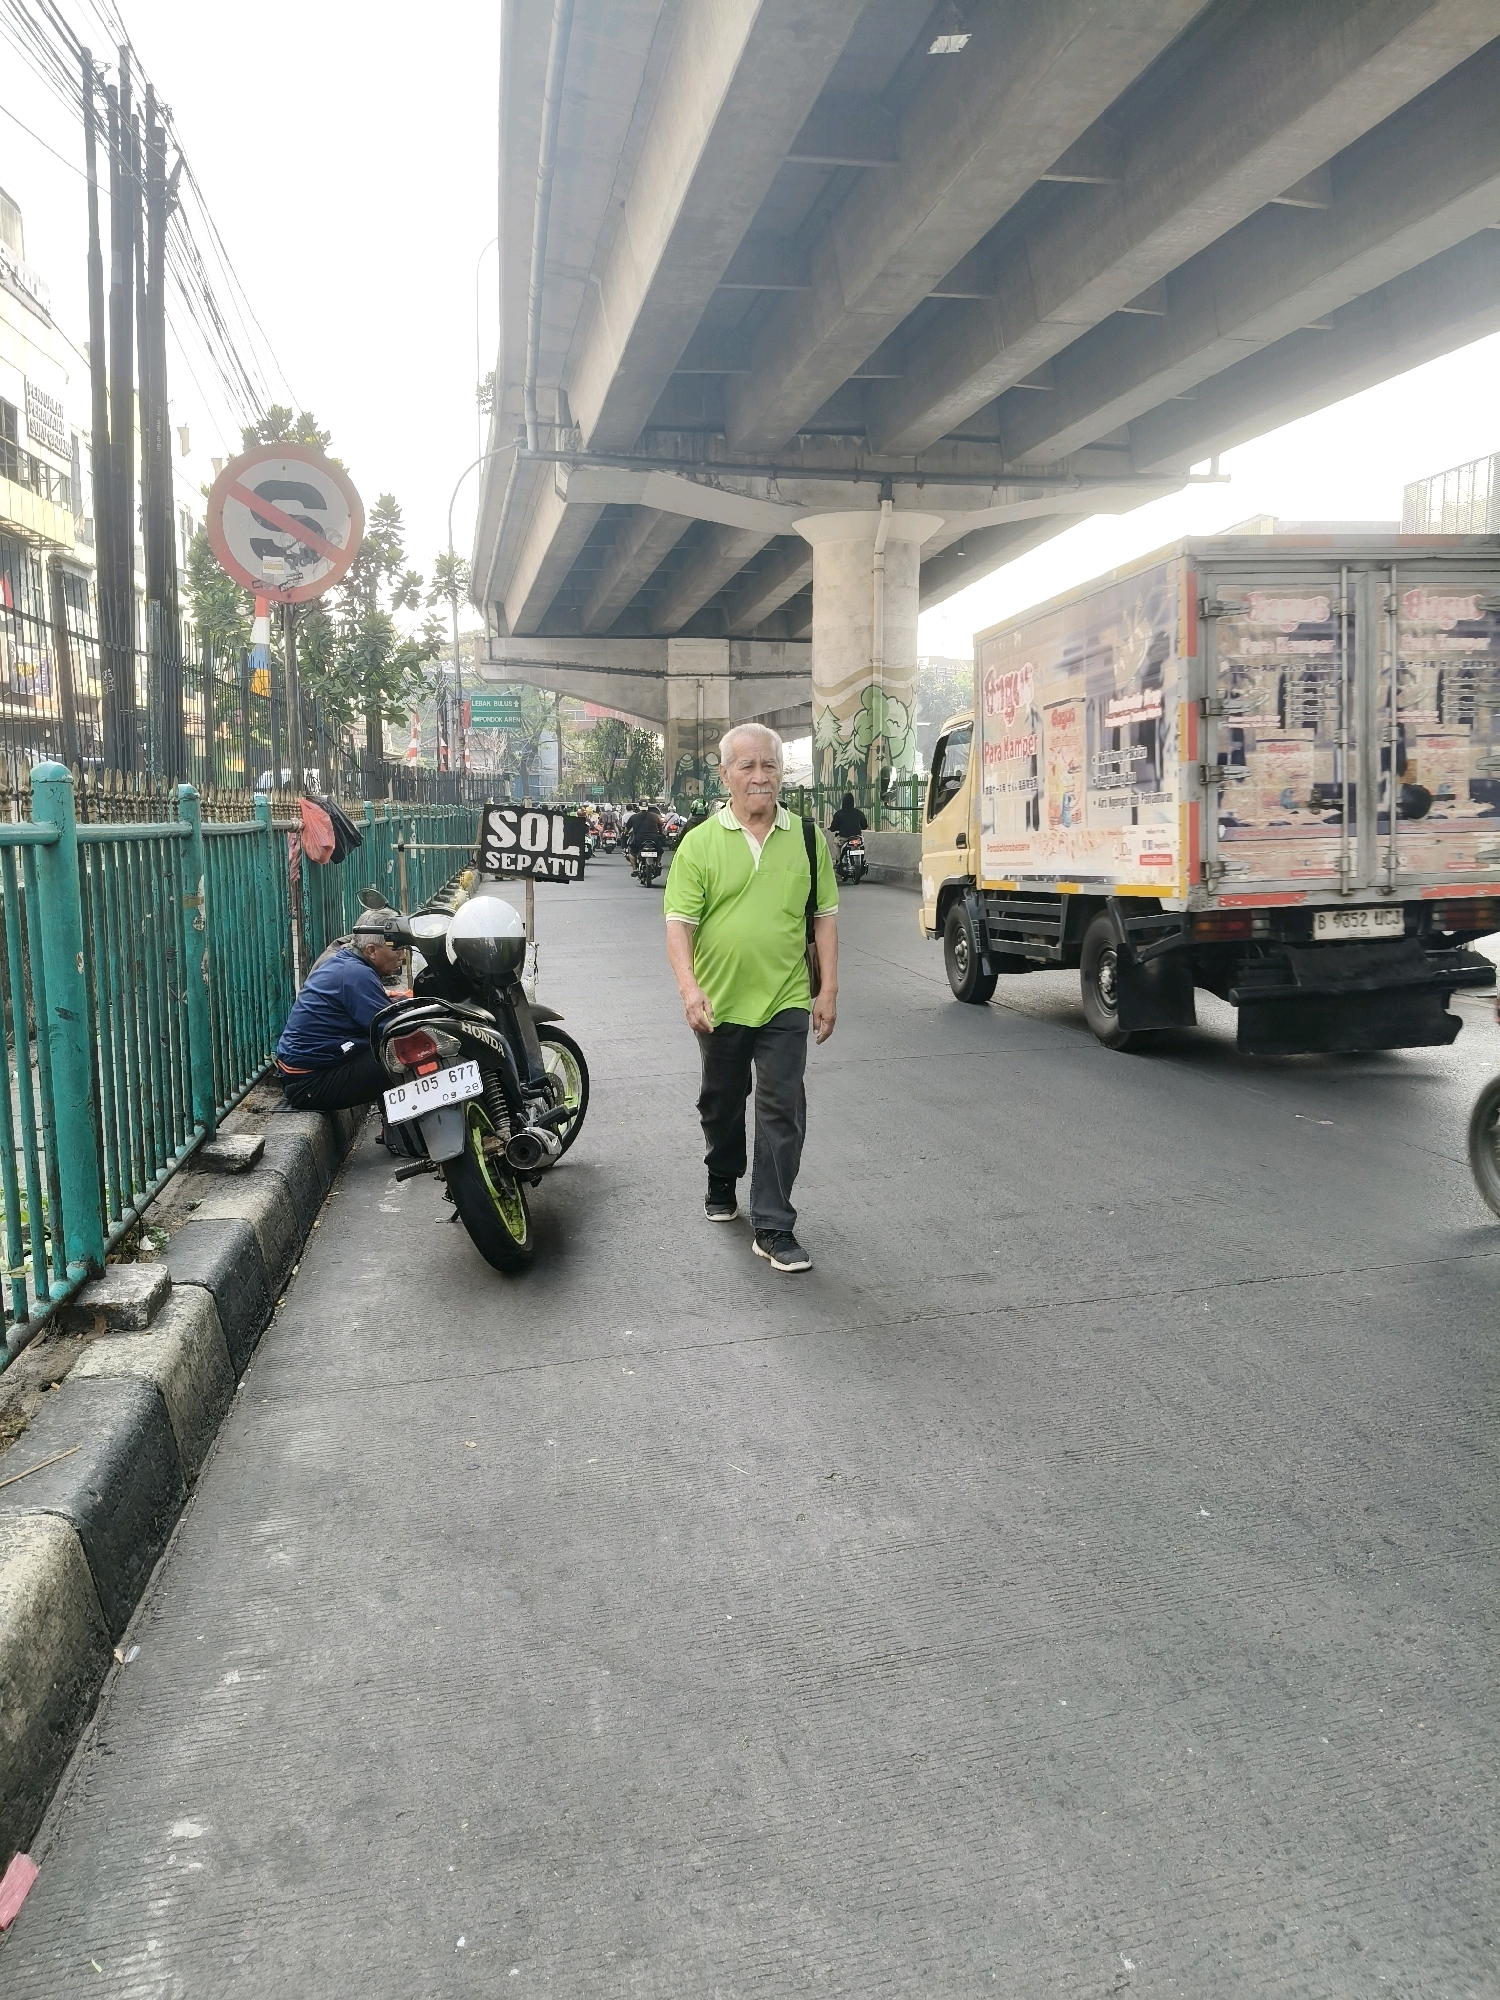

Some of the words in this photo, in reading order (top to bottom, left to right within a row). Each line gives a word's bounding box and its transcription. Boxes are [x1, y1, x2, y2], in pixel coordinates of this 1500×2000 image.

[984, 741, 1001, 765] Para
[1003, 734, 1038, 763] Kamper
[487, 810, 580, 856] SOL
[485, 851, 579, 876] SEPATU
[1318, 914, 1327, 930] B
[460, 1021, 506, 1059] HONDA
[388, 1088, 406, 1105] CD
[414, 1075, 439, 1095] 105
[448, 1064, 475, 1083] 677
